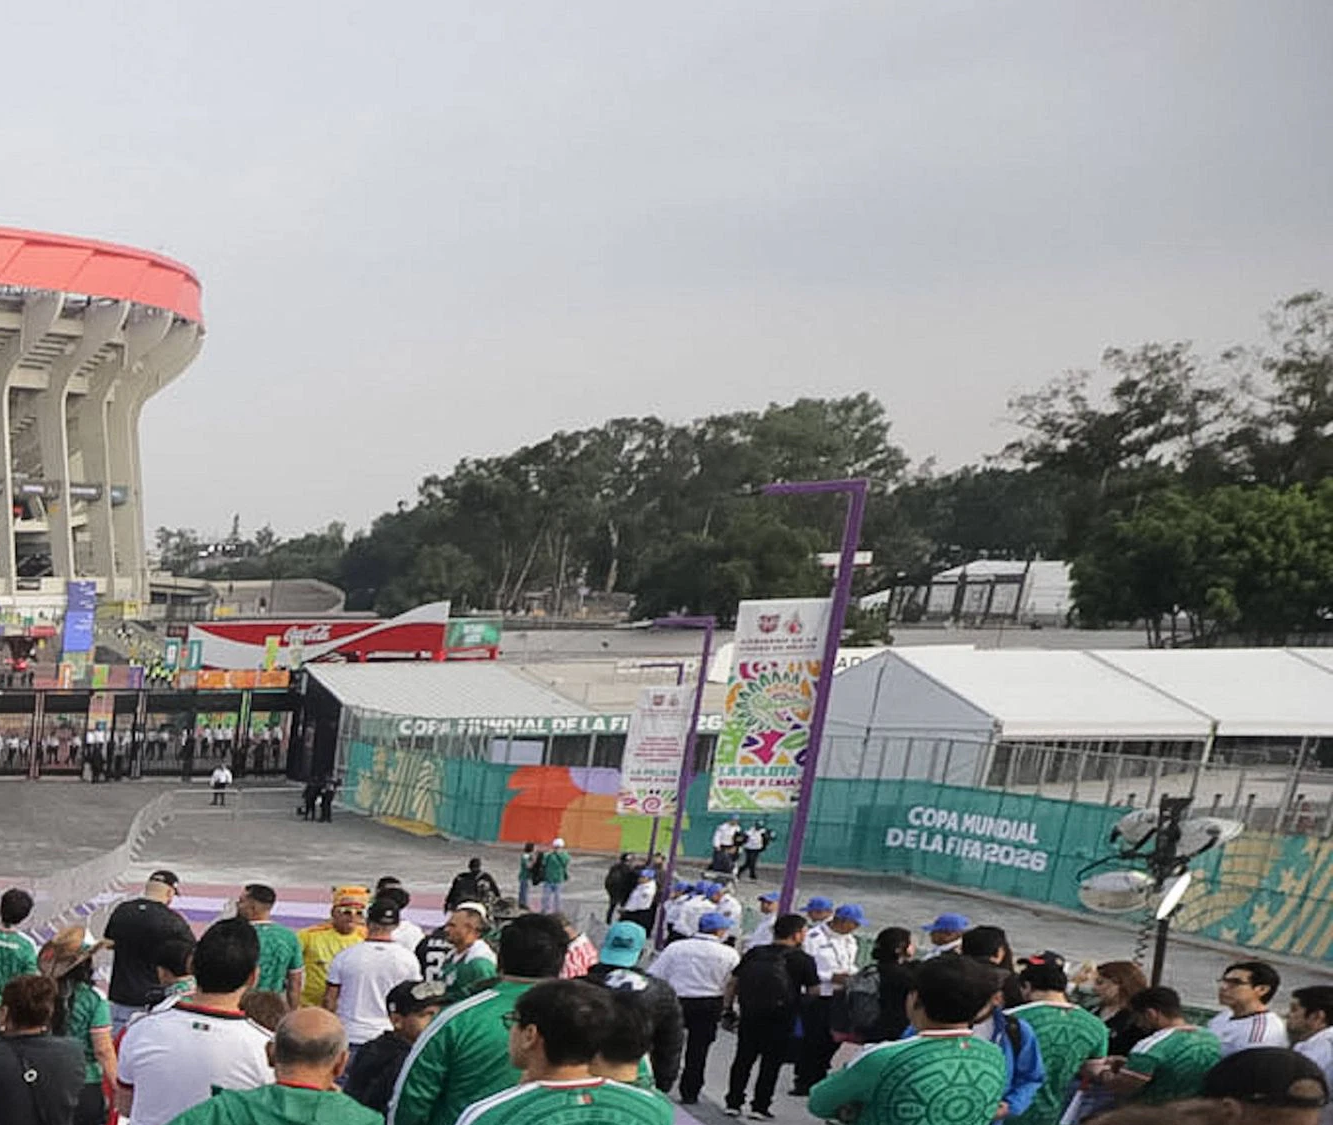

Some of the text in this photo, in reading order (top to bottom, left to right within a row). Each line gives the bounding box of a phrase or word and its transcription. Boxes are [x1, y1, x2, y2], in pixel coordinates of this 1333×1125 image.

[399, 715, 724, 736] COPA MUNDIAL DE LA FI 26
[908, 806, 1039, 844] COPA MUNDIAL
[885, 827, 1048, 872] DE LA FIFA 2026
